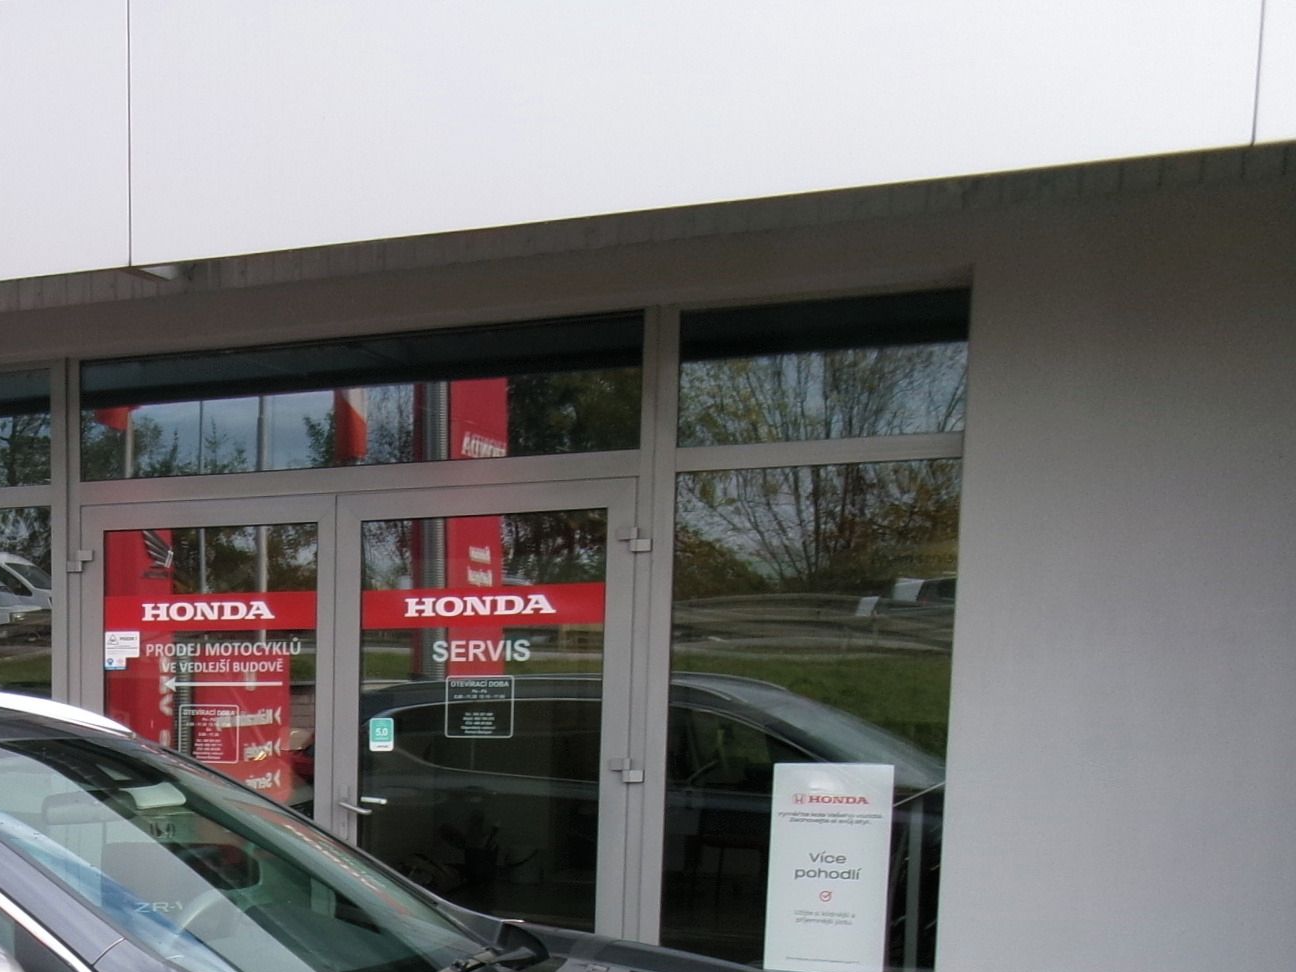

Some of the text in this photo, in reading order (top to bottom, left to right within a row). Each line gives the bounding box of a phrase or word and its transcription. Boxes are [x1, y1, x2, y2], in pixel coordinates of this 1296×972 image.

[142, 601, 275, 621] HONDA
[404, 594, 557, 617] HONDA
[145, 643, 201, 658] PRODEJ
[205, 637, 301, 657] MOTOCYKLŮ
[432, 639, 531, 662] SERVIS
[161, 658, 284, 674] VE VEDLEJŠÍ BUDOVĚ
[808, 795, 869, 805] HONDA
[809, 851, 847, 864] Více
[794, 868, 862, 881] pohodlí
